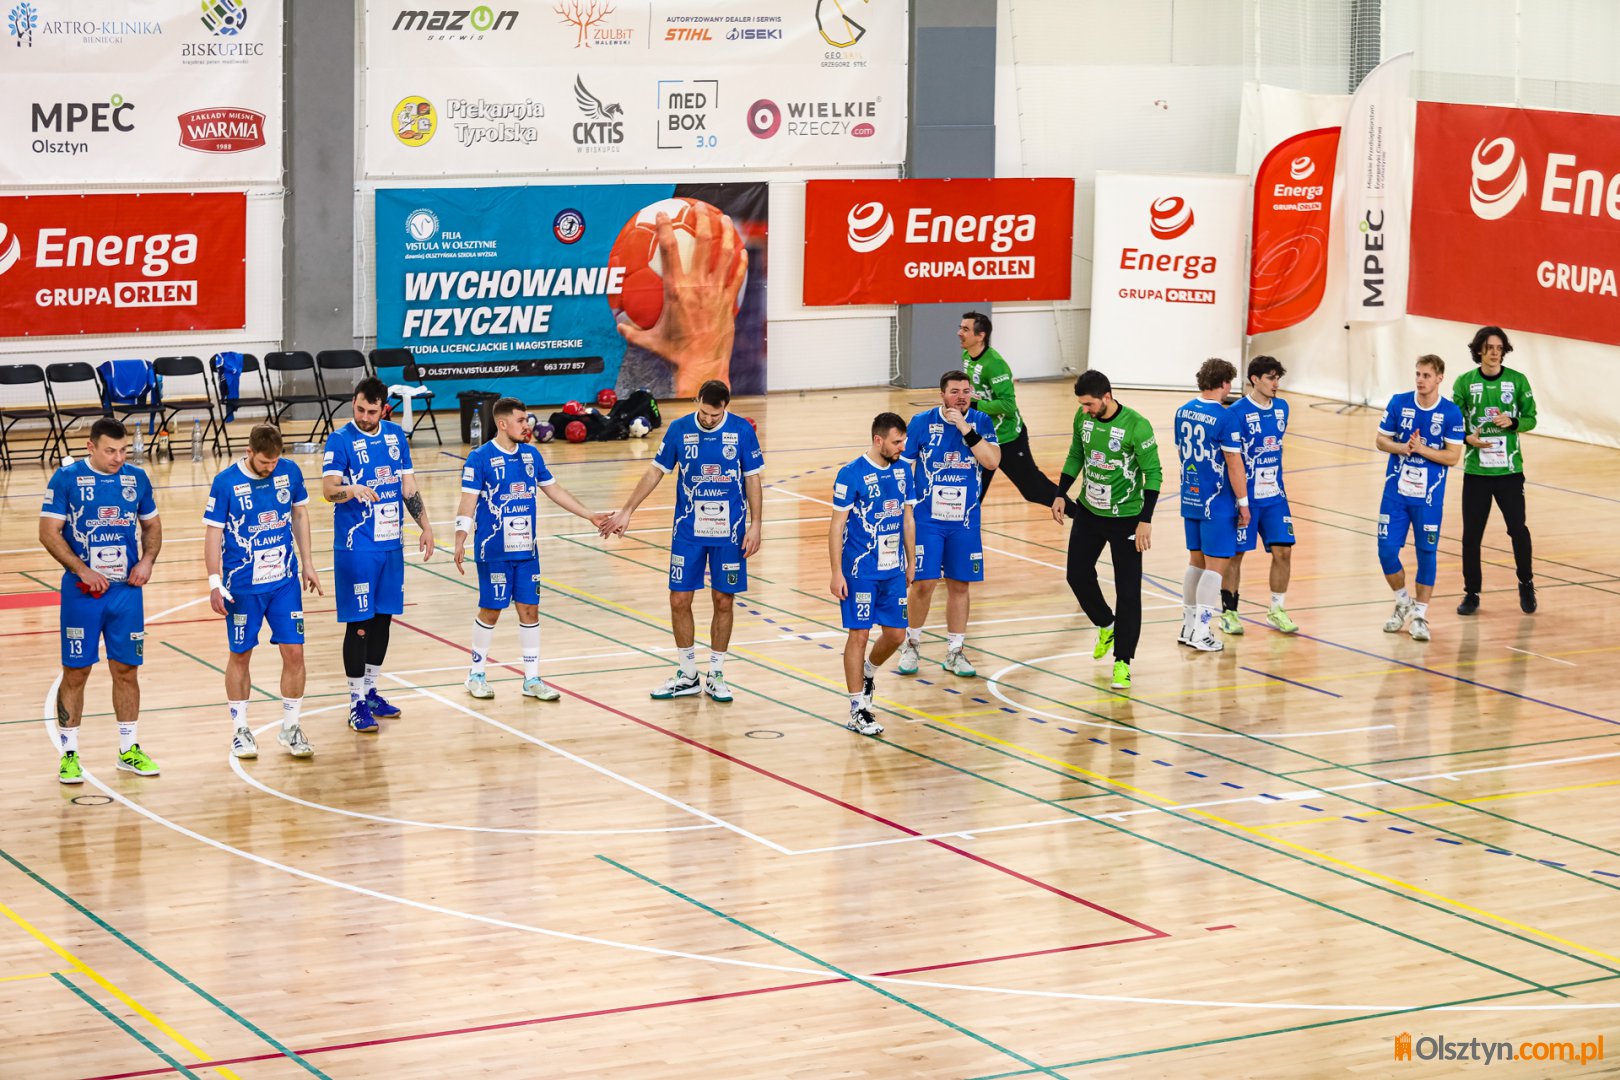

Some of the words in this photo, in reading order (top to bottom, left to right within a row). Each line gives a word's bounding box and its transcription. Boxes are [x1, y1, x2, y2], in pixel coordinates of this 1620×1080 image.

[42, 21, 163, 34] ARTRO-KLINIKA
[664, 28, 713, 41] STIHL
[740, 29, 782, 39] ISEKI
[82, 36, 123, 44] BIENIECKI
[181, 42, 264, 56] BISKUPIEC
[668, 92, 707, 109] MED
[446, 98, 545, 121] Piekarnia
[787, 101, 876, 118] WIELKIE
[31, 102, 136, 133] MPEC
[668, 114, 706, 131] BOX
[186, 121, 259, 140] WARMIA
[454, 123, 538, 147] Tyrolska
[572, 121, 624, 145] CKTiS
[787, 121, 851, 136] RZECZY
[32, 139, 88, 156] Olsztyn
[696, 135, 718, 148] 3.0
[1273, 184, 1324, 200] Energa
[441, 231, 462, 240] FILIA
[904, 207, 1036, 253] Energa
[35, 227, 198, 277] Energa
[405, 242, 440, 251] VISTULA
[441, 241, 452, 250] W
[452, 240, 497, 250] OLSZTYNIE
[1119, 247, 1217, 280] Energa
[1362, 209, 1384, 307] MPEC
[903, 261, 967, 279] GRUPA
[971, 259, 1031, 277] ORLEN
[404, 266, 627, 302] WYCHOWANIE
[1536, 260, 1619, 298] GRUPA
[35, 287, 112, 307] GRUPA
[118, 284, 193, 304] ORLEN
[1118, 288, 1164, 301] GRUPA
[1167, 289, 1214, 304] ORLEN
[402, 304, 553, 338] FIZYCZNE
[440, 342, 508, 354] LICENCJACKIE
[509, 342, 514, 351] I
[515, 339, 583, 351] MAGISTERSKIE
[427, 364, 520, 377] OLSZTYN.VISTULA.EDU.PL
[543, 363, 558, 371] 663
[558, 362, 572, 370] 737
[572, 362, 586, 370] 857
[1470, 392, 1483, 405] 77
[1248, 422, 1262, 435] 34
[1400, 417, 1413, 431] 44
[928, 433, 943, 447] 27
[1081, 430, 1091, 444] 30
[1180, 420, 1207, 463] 33
[356, 450, 370, 465] 16
[684, 444, 699, 460] 20
[493, 466, 506, 480] 17
[79, 486, 95, 501] 13
[694, 488, 723, 497] IŁAWA
[867, 483, 881, 499] 23
[237, 495, 253, 511] 15
[90, 532, 121, 543] IŁAWA
[1236, 528, 1247, 542] 34
[1378, 524, 1389, 537] 44
[671, 566, 683, 580] 20
[493, 583, 506, 598] 17
[356, 594, 369, 609] 16
[856, 603, 870, 618] 23
[234, 626, 245, 641] 15
[69, 639, 83, 655] 13
